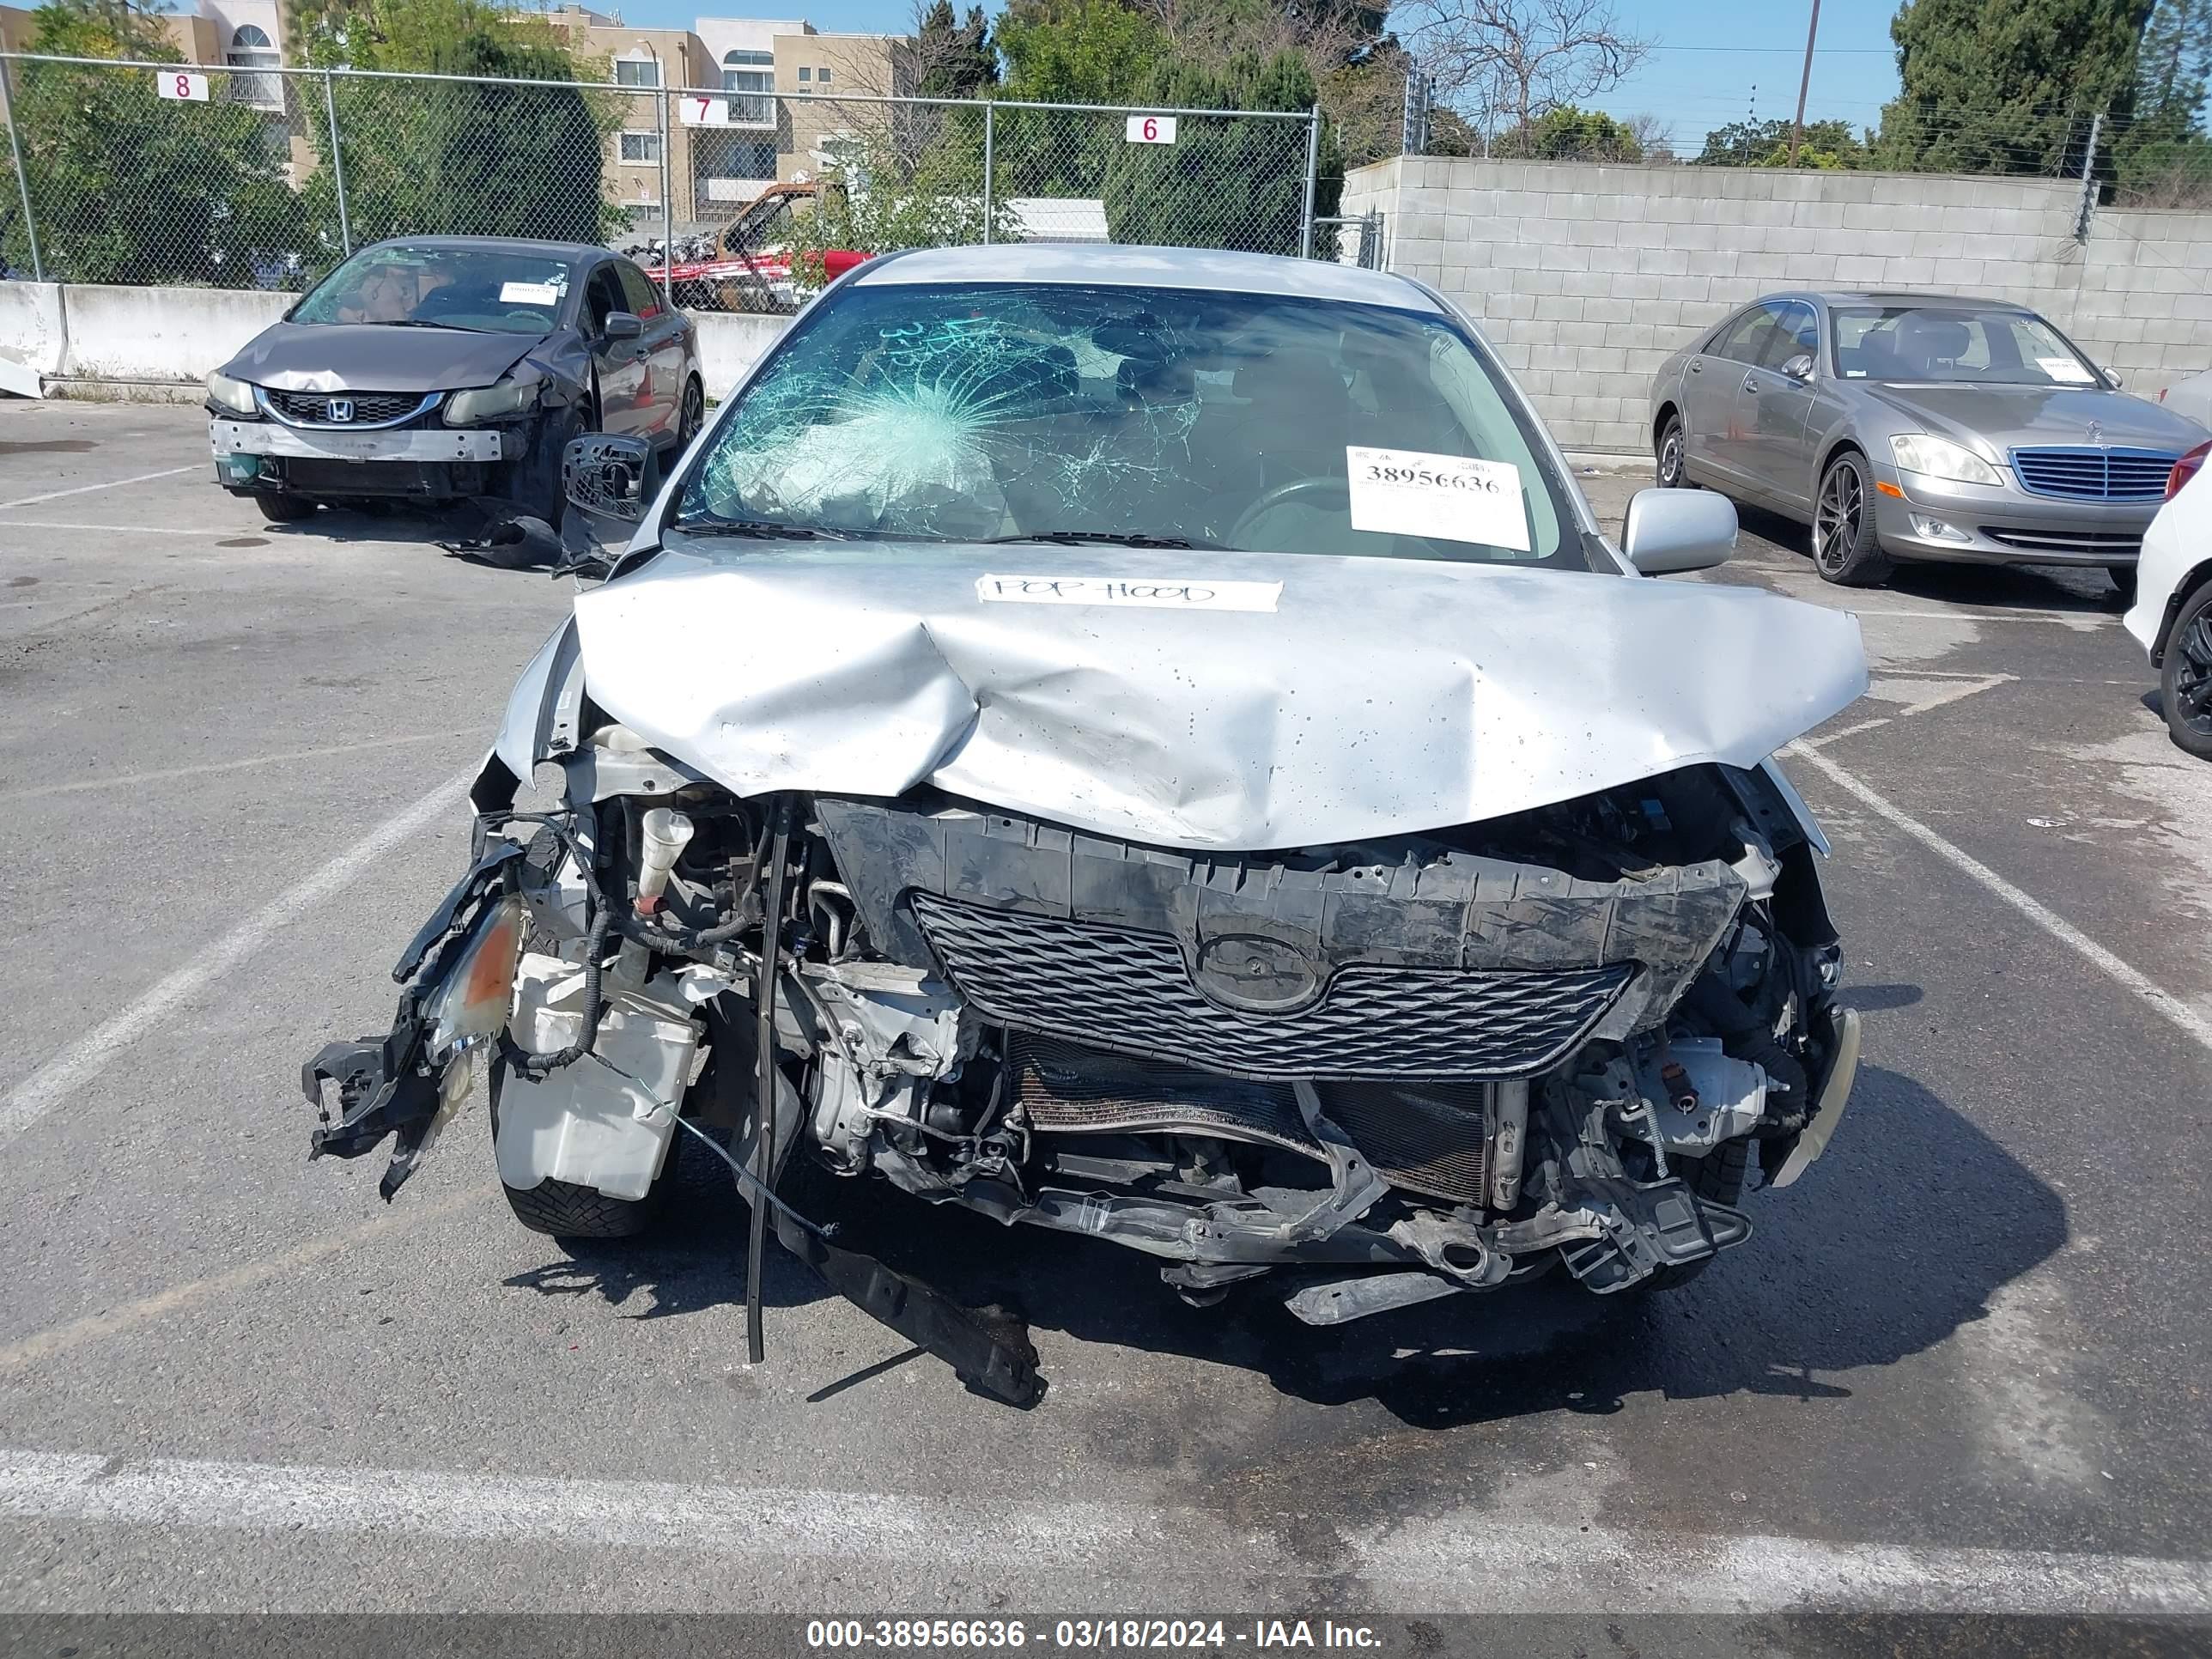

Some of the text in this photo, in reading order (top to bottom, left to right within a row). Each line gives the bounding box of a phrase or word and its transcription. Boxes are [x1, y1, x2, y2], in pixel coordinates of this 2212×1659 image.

[176, 75, 190, 97] 8
[696, 98, 710, 121] 7
[1144, 118, 1157, 140] 6
[1366, 465, 1500, 494] 38956636
[994, 580, 1215, 603] POP HOOD
